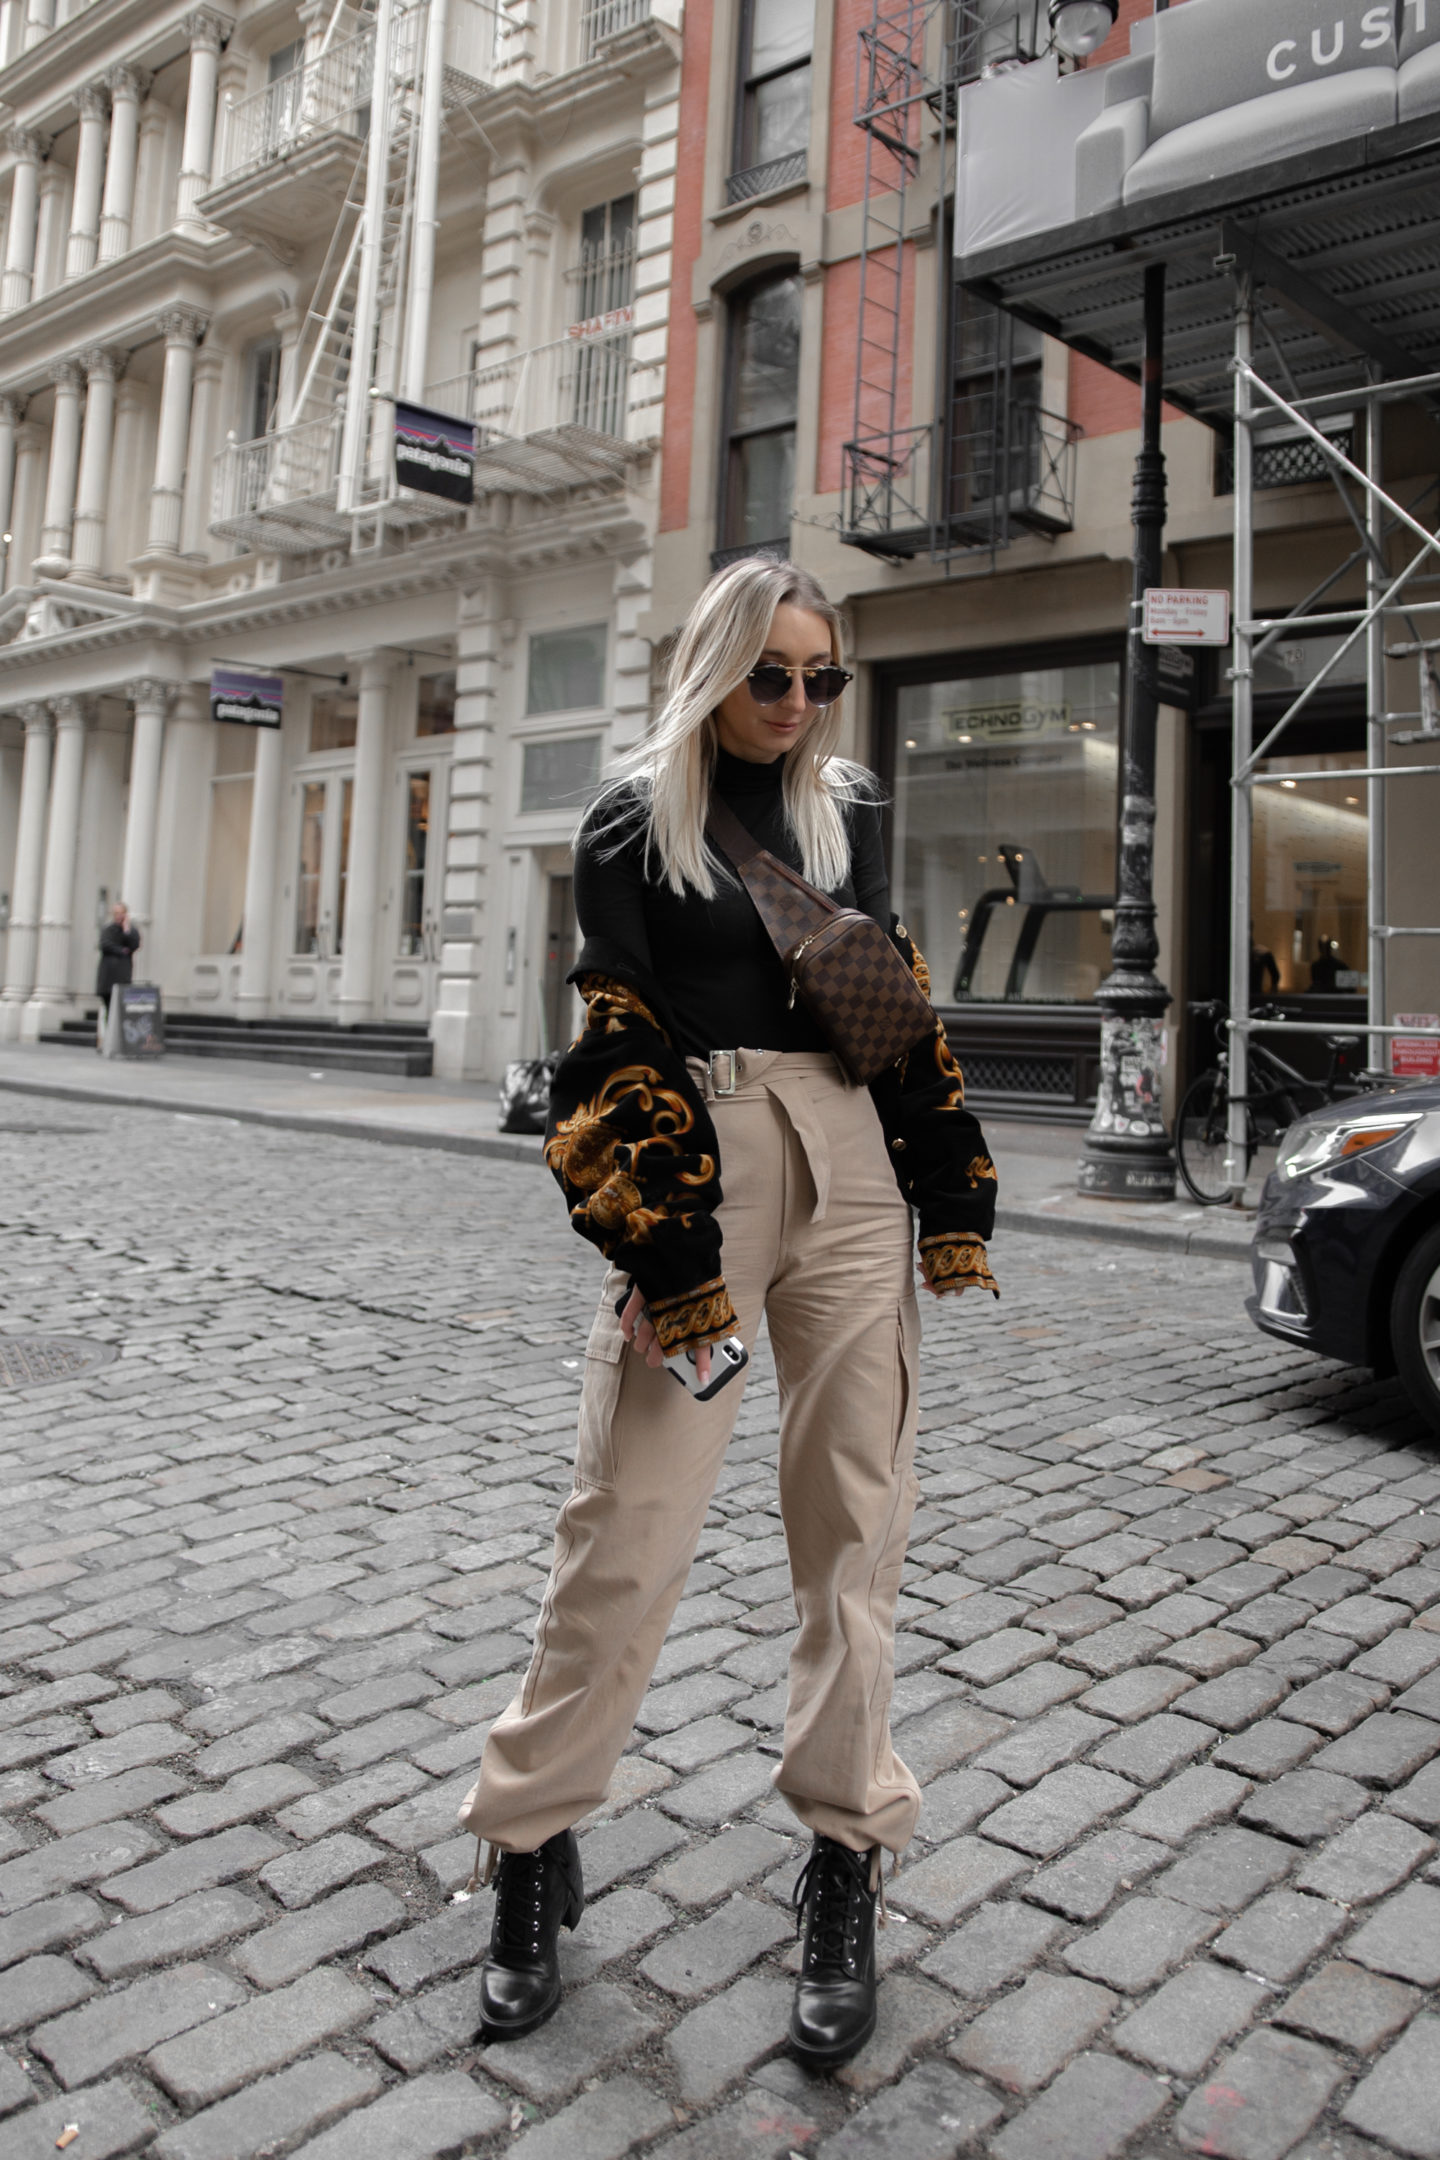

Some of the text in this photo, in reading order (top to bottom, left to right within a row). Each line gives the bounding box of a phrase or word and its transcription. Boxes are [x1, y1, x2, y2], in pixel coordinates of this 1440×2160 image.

[397, 444, 471, 478] patagonia
[1151, 595, 1208, 605] NO PARKING
